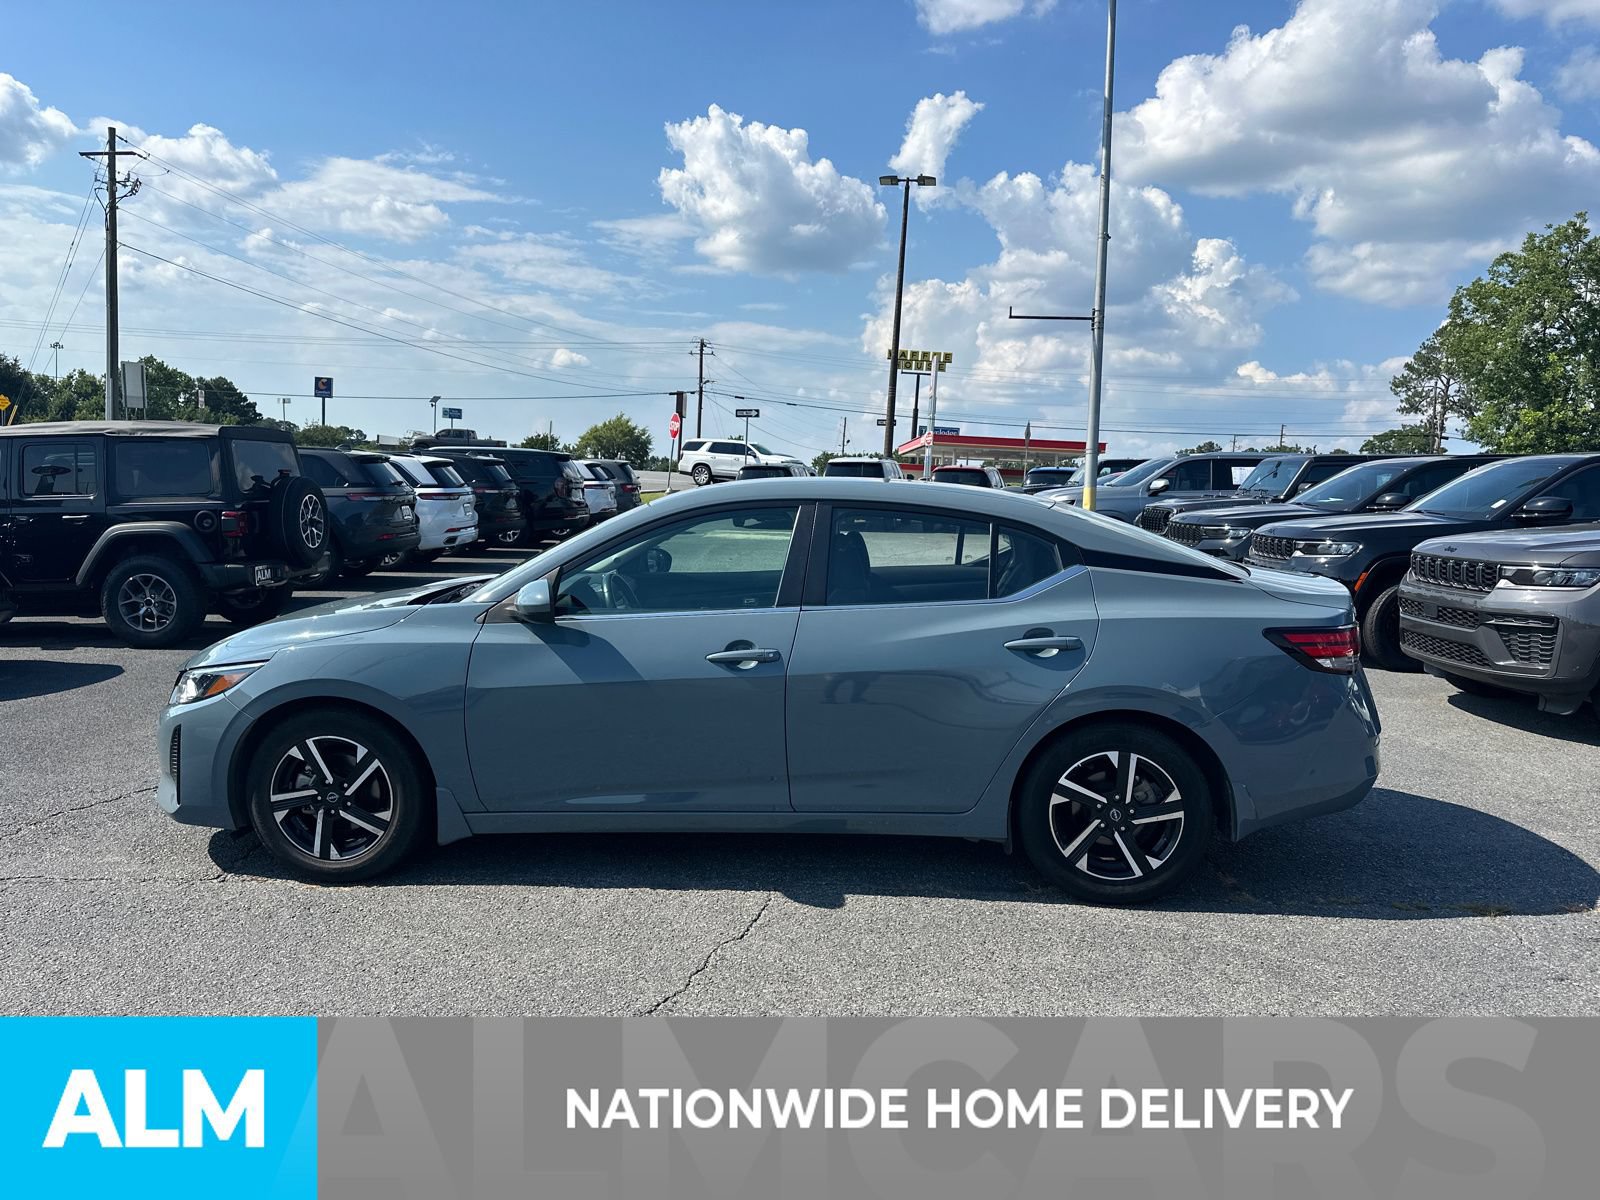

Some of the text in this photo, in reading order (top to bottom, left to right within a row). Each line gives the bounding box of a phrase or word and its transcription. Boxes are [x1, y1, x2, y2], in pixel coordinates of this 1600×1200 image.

[889, 350, 951, 361] AFFE
[898, 361, 945, 371] OUSE
[669, 420, 680, 431] STOP
[258, 569, 272, 581] ALM
